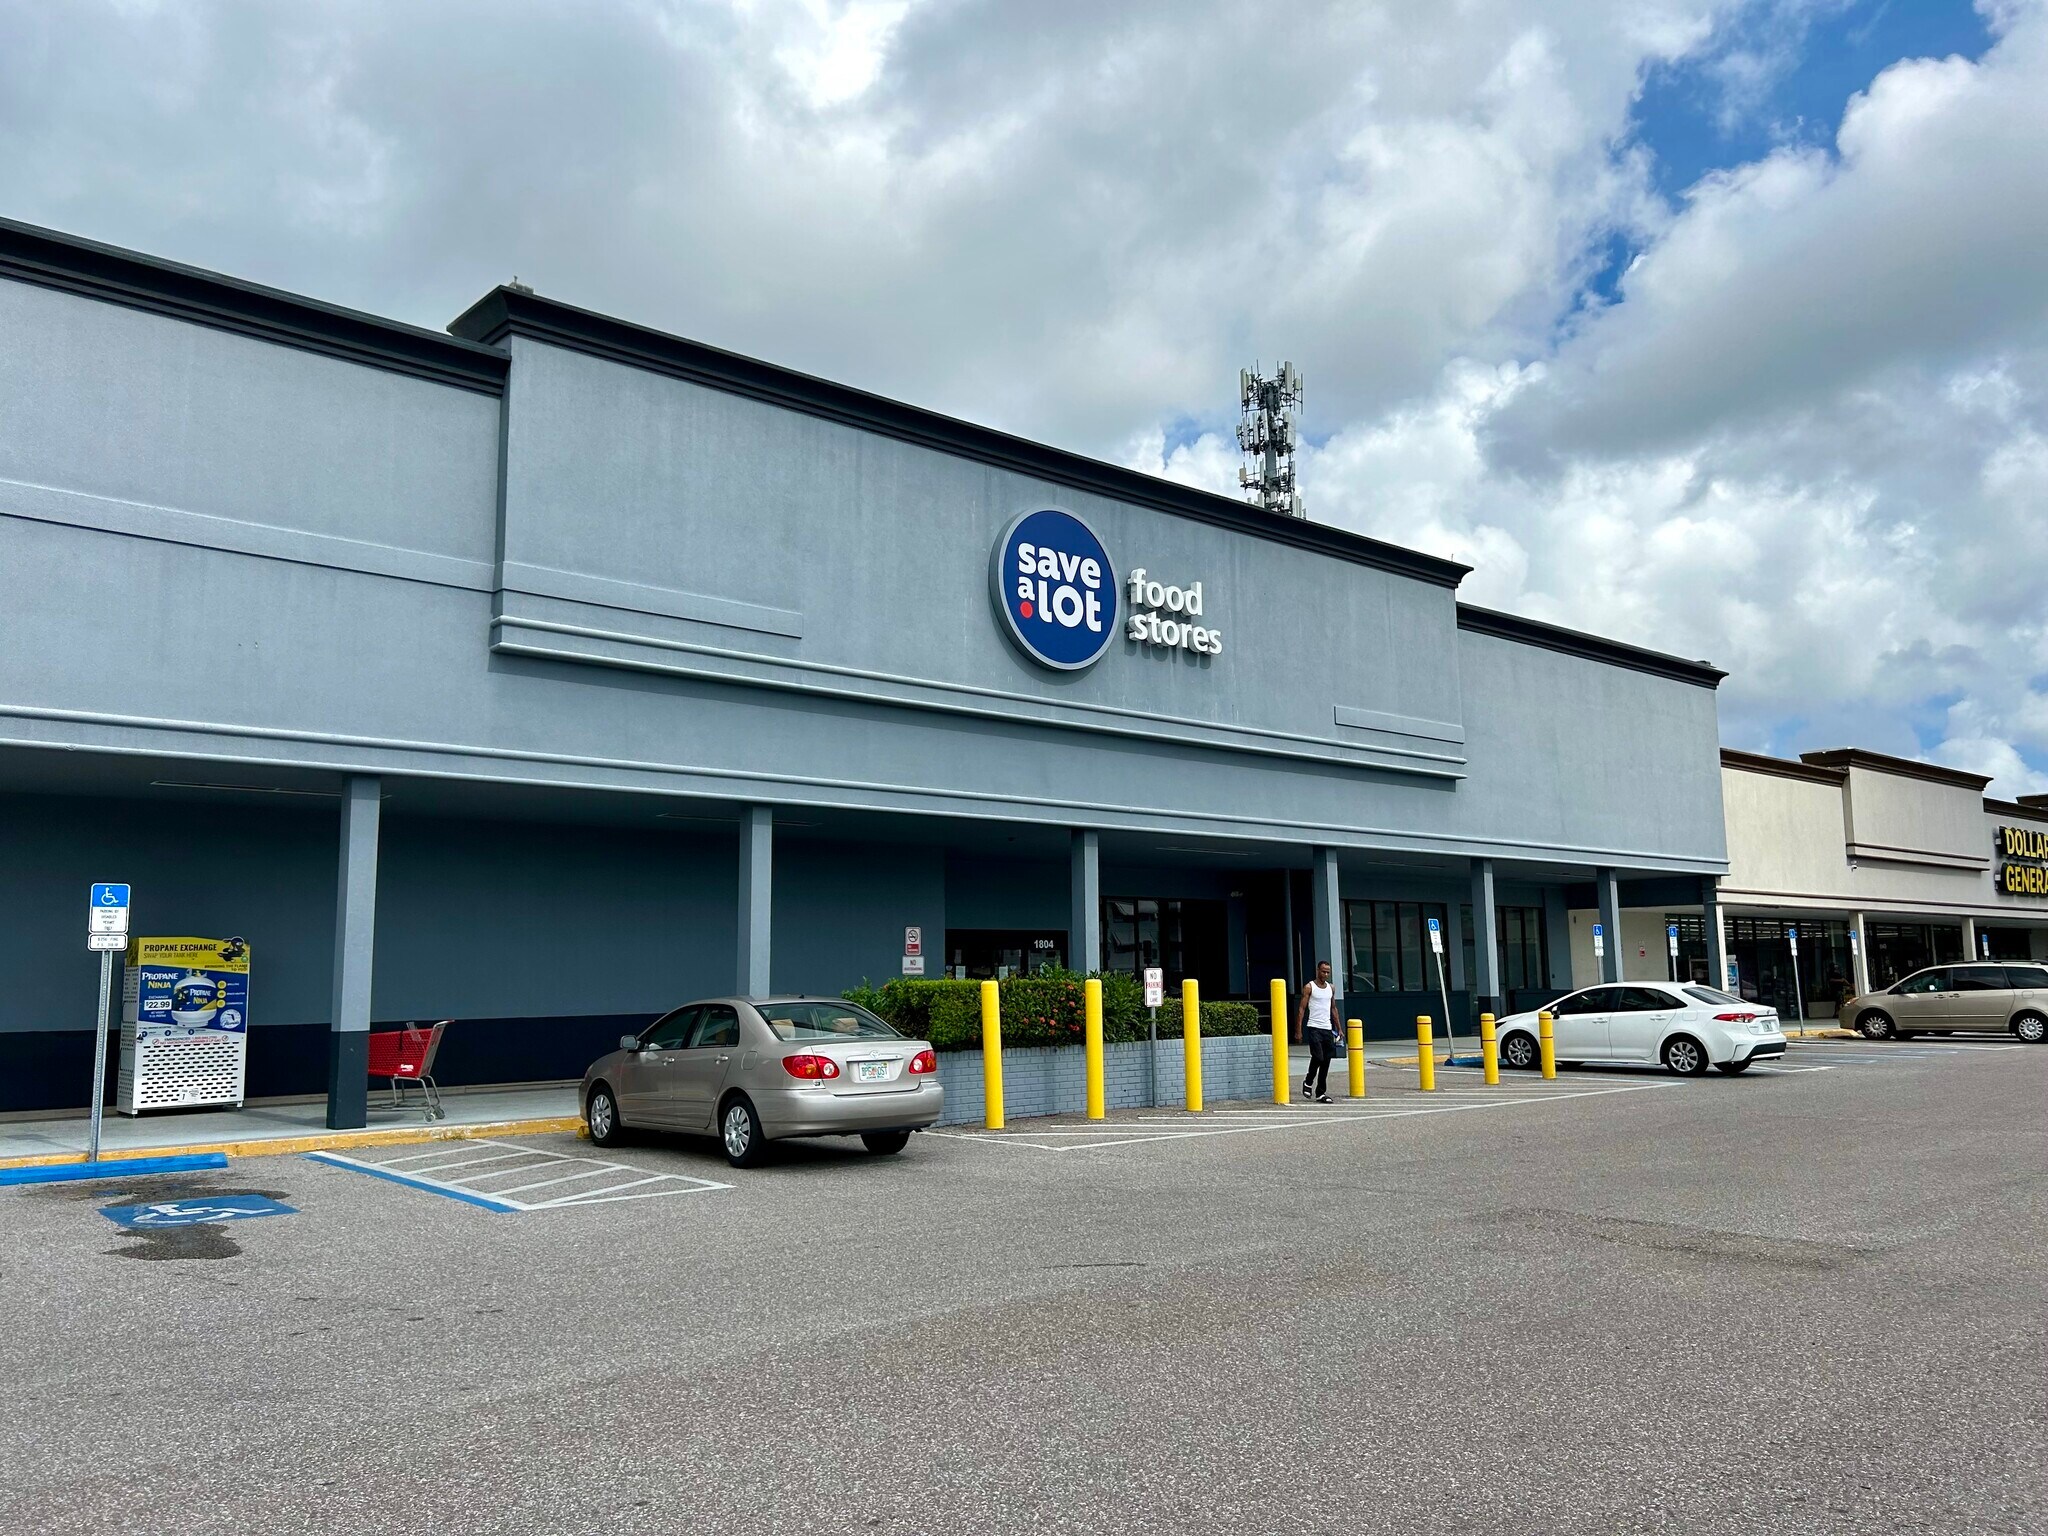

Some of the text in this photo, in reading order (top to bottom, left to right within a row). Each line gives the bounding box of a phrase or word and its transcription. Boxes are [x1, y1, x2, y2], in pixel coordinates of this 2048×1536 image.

[1017, 542, 1101, 589] save
[1017, 576, 1036, 601] a
[1127, 568, 1203, 617] food
[1128, 611, 1223, 656] stores
[144, 943, 217, 952] PROPANE EXCHANGE
[1033, 939, 1054, 949] 1804
[142, 972, 179, 980] PROPANE
[147, 980, 172, 989] NINJA
[190, 988, 212, 997] PROPANE
[145, 1000, 171, 1009] $22.99
